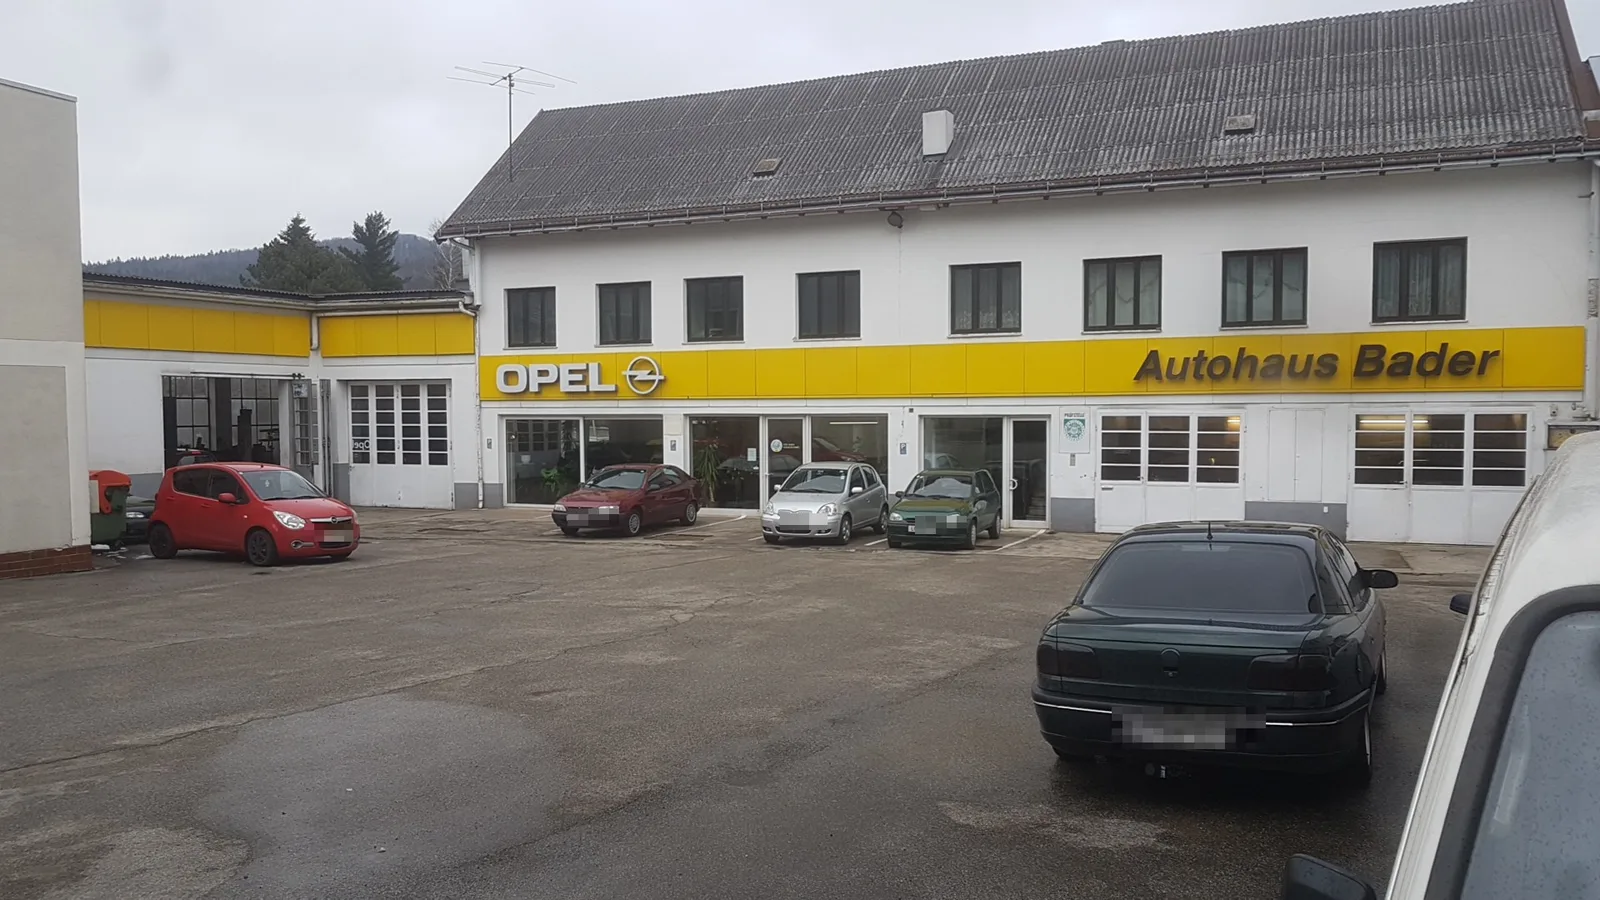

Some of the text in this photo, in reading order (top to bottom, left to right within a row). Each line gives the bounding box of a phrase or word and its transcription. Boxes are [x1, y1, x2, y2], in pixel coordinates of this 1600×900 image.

[496, 362, 616, 393] OPEL
[1133, 343, 1501, 381] Autohaus Bader
